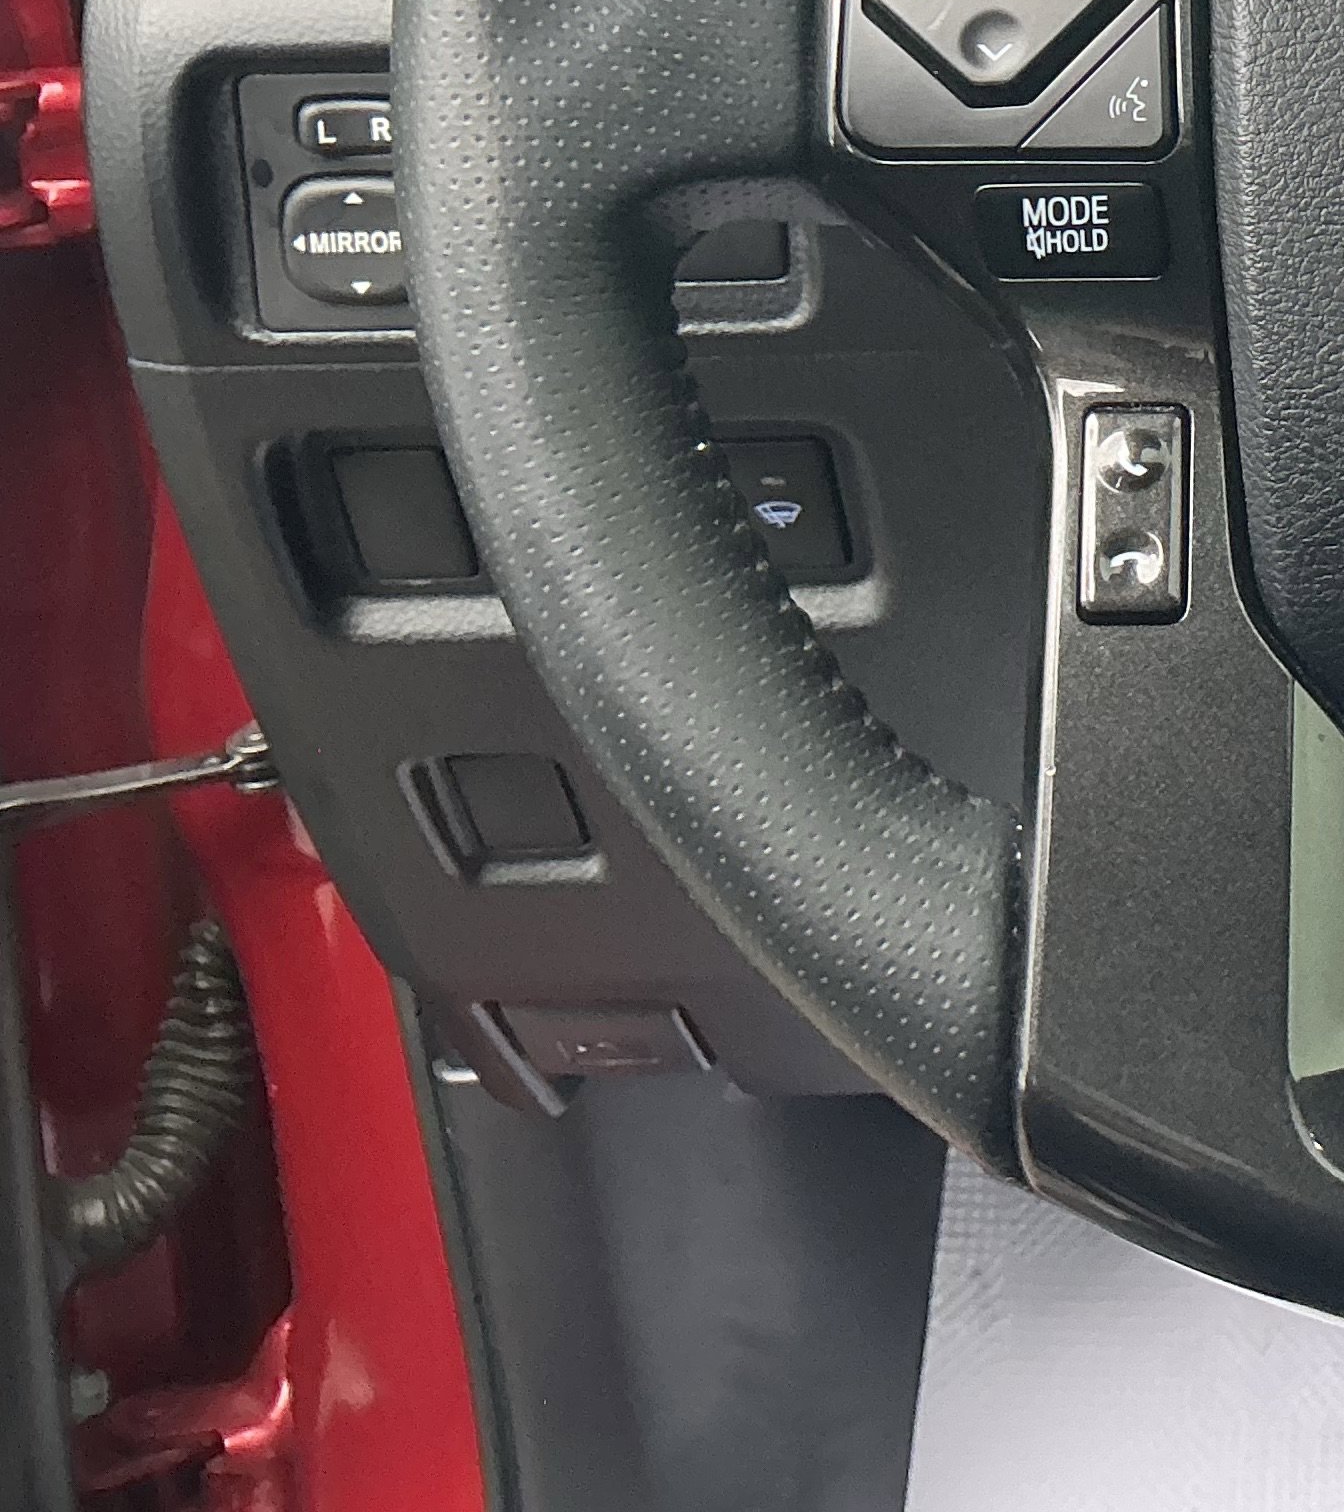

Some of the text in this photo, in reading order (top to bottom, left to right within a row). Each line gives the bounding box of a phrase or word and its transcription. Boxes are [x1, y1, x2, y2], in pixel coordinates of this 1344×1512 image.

[316, 116, 393, 145] L R
[1021, 194, 1111, 228] MODE
[1046, 228, 1110, 255] HOLD
